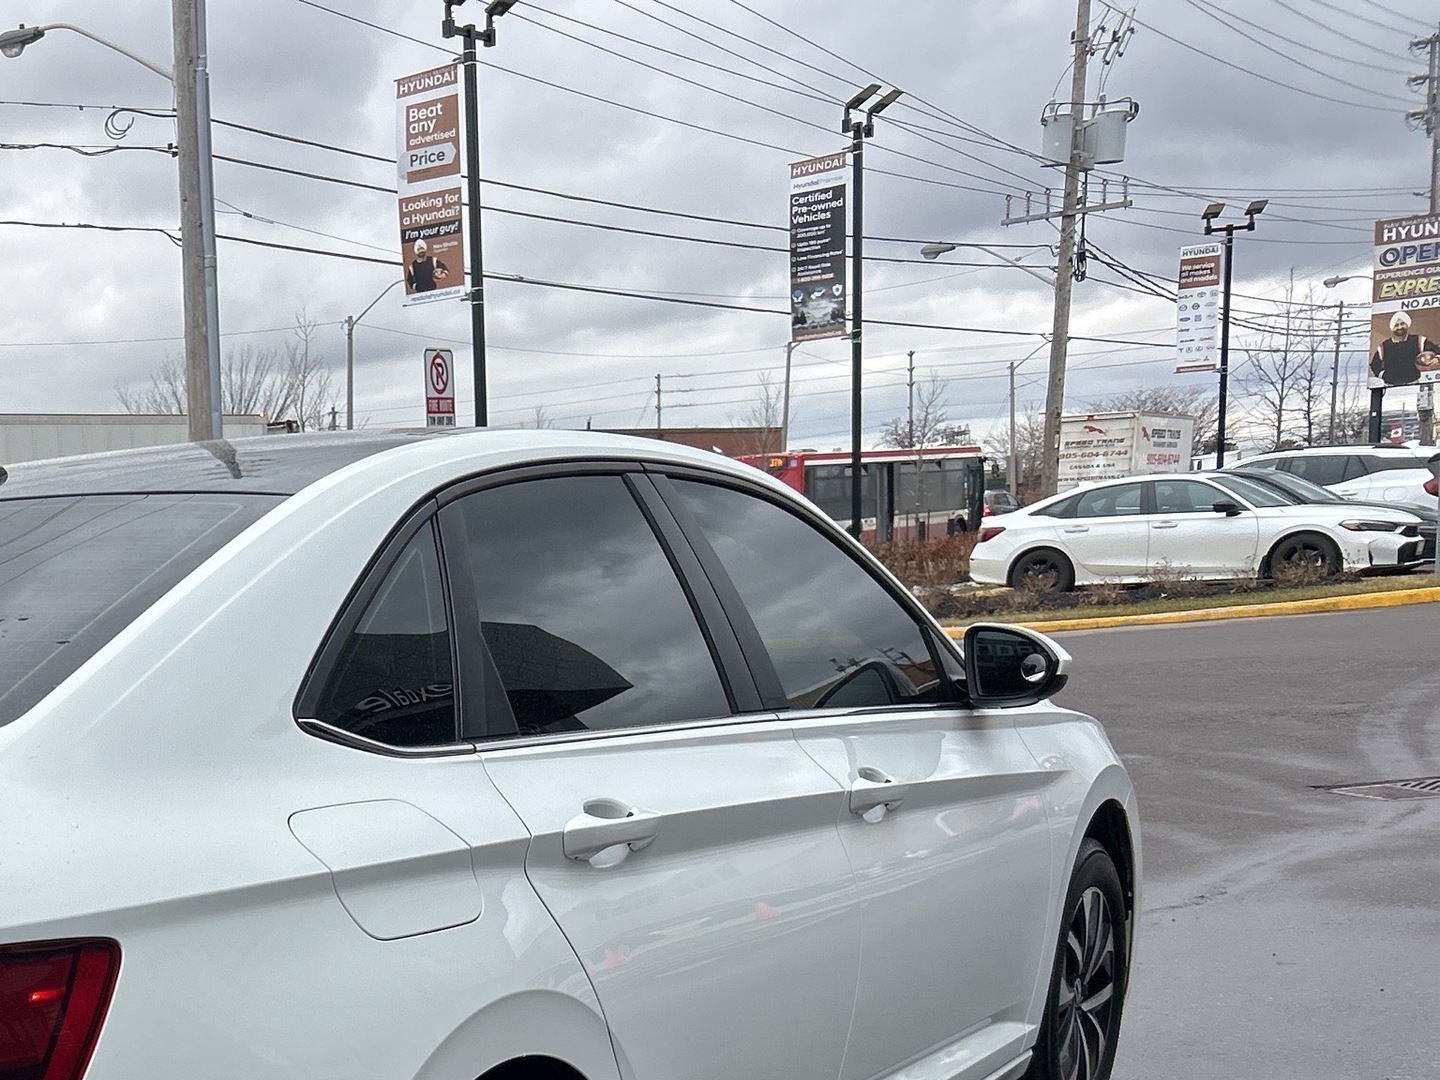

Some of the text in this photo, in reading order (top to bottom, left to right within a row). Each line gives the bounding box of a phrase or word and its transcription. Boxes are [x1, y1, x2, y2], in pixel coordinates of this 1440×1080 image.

[399, 70, 455, 95] HYUNDAI
[408, 102, 443, 122] Beat
[408, 118, 437, 134] any
[409, 128, 456, 146] advertised
[409, 150, 446, 167] Price
[792, 157, 843, 176] HYUNDAI
[402, 193, 460, 212] Looking for
[791, 189, 833, 205] Certified
[791, 197, 844, 215] Pre-owned
[402, 205, 460, 225] a Hyundai?
[791, 211, 832, 225] Vehicles
[405, 221, 459, 240] I'm your guy!
[1182, 245, 1219, 257] HYUNDAI
[1192, 261, 1215, 270] service
[1375, 267, 1425, 281] EXPERIENCE
[1400, 299, 1420, 310] NO
